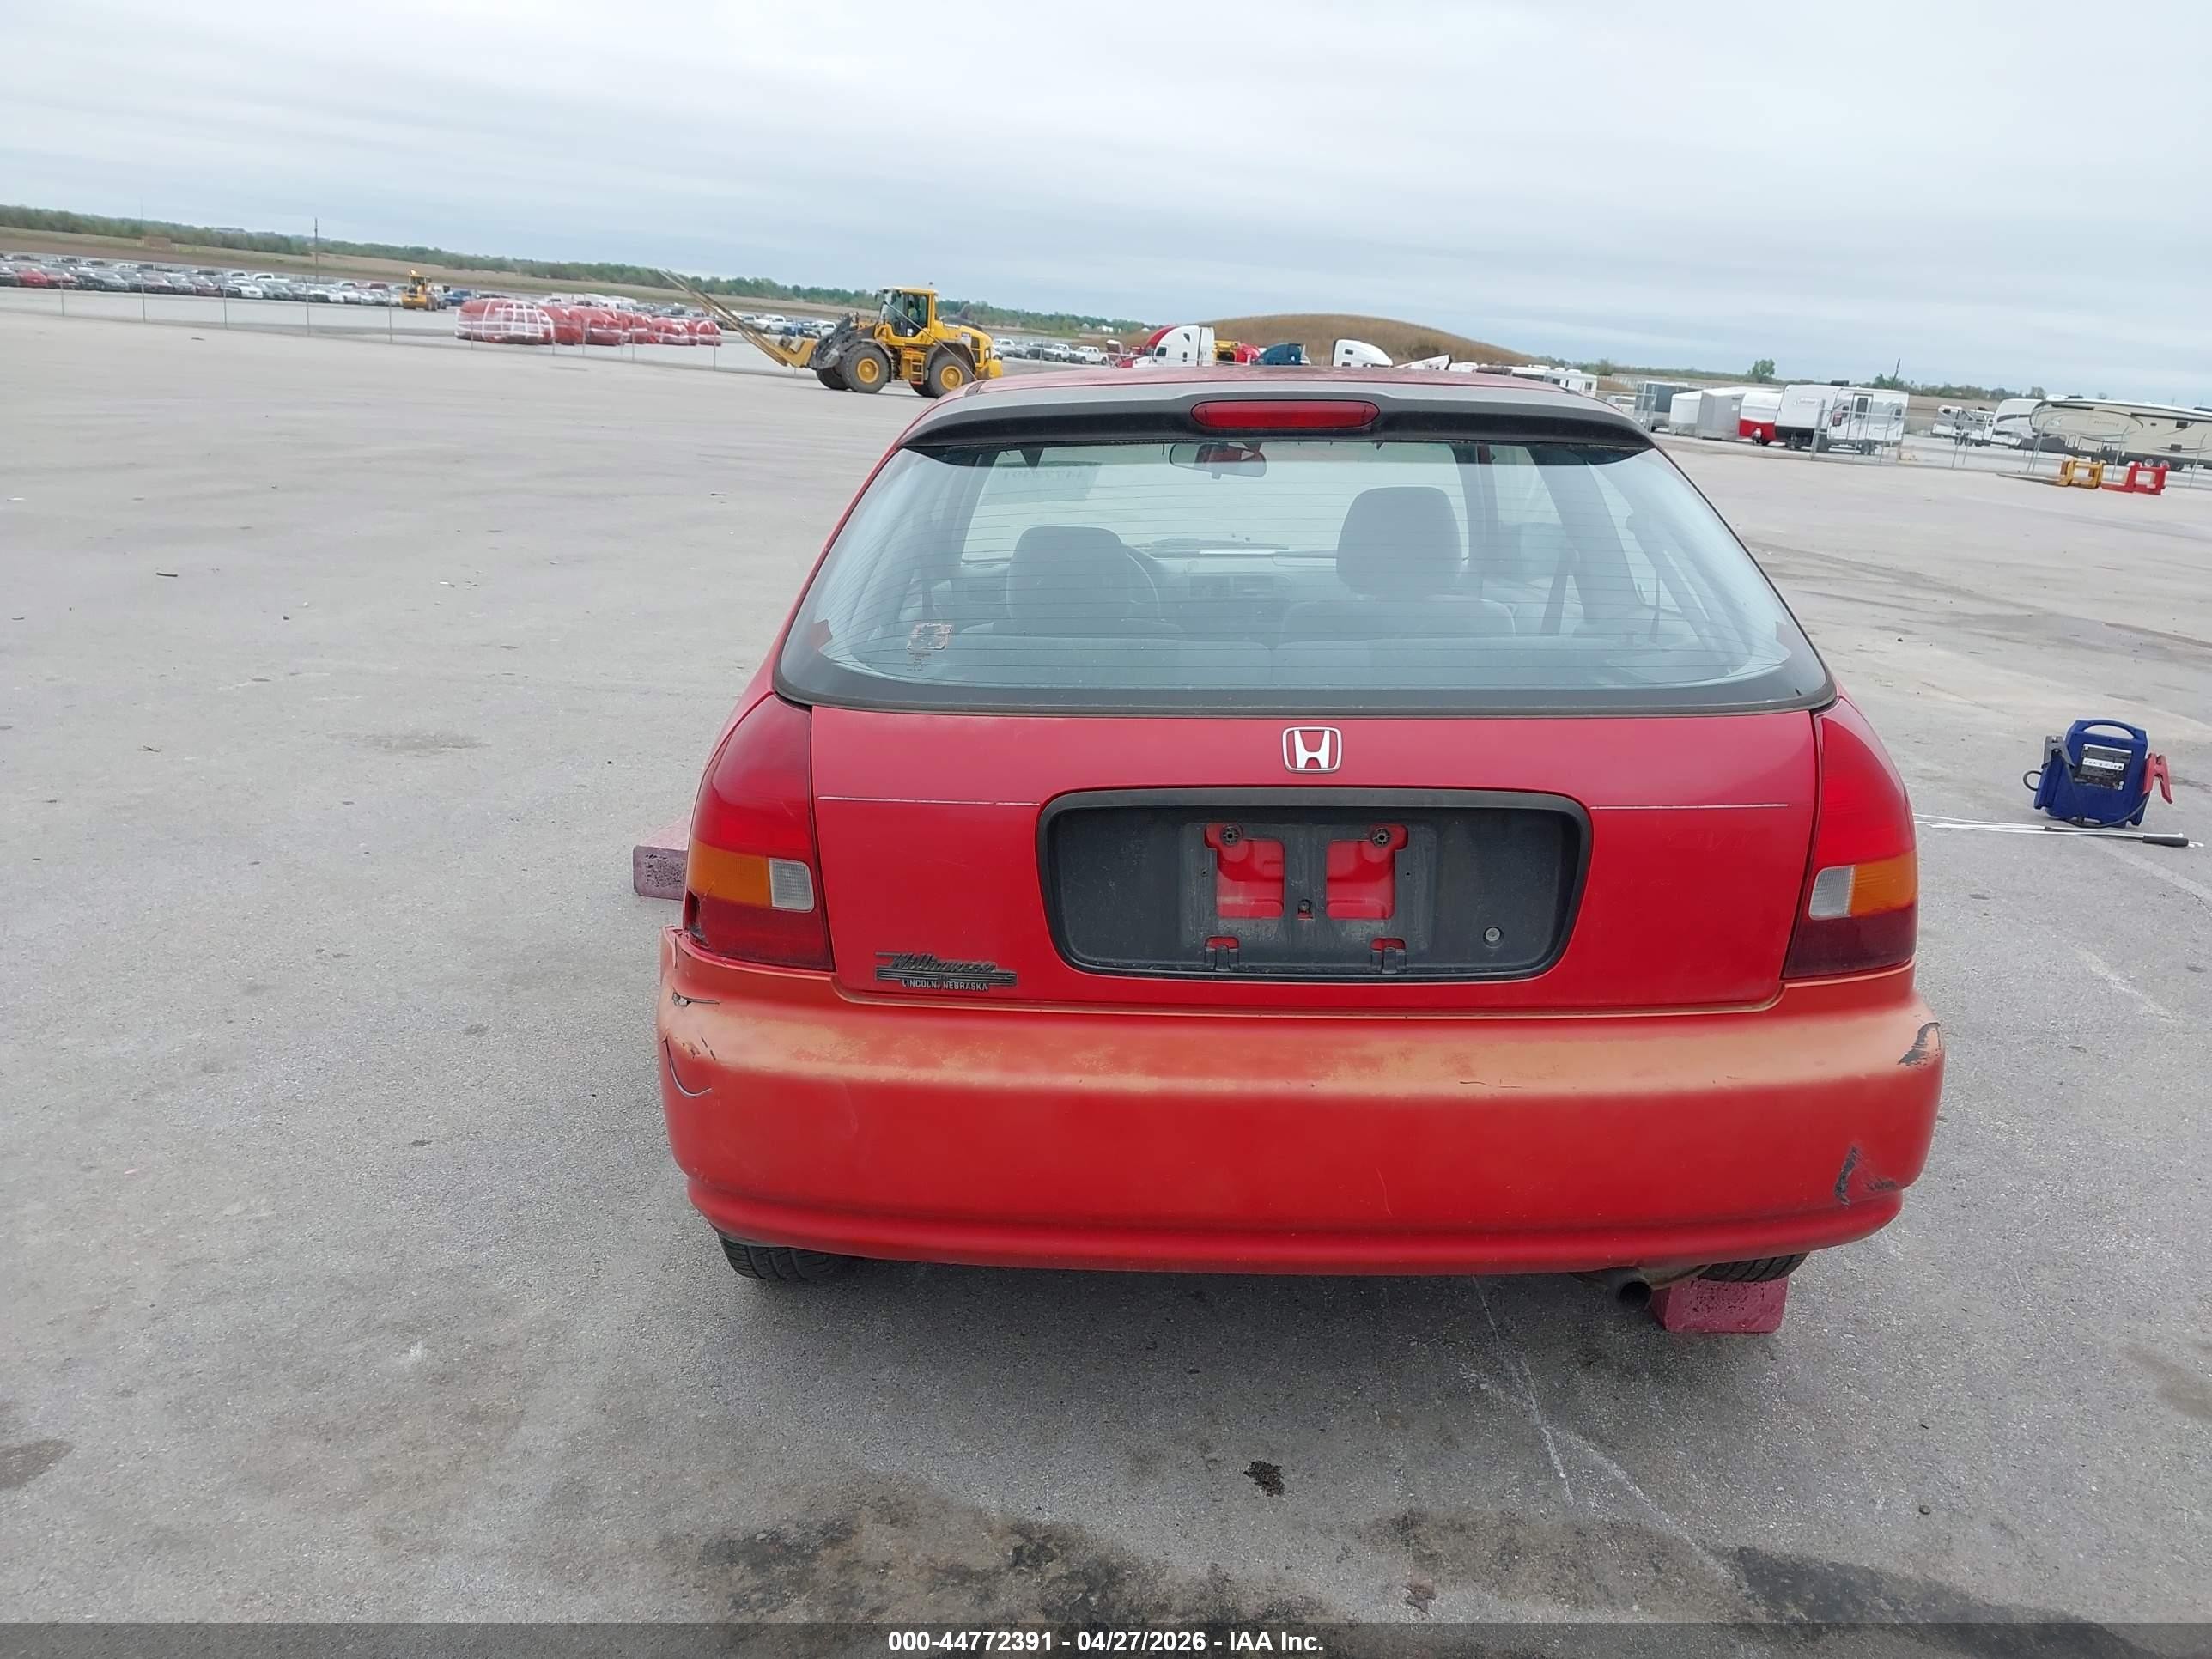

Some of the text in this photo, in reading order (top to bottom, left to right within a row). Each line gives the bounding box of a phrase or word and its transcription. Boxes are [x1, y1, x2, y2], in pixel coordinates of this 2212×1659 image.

[1291, 727, 1334, 770] H
[902, 978, 988, 992] LINCOLN, NEBRASKA
